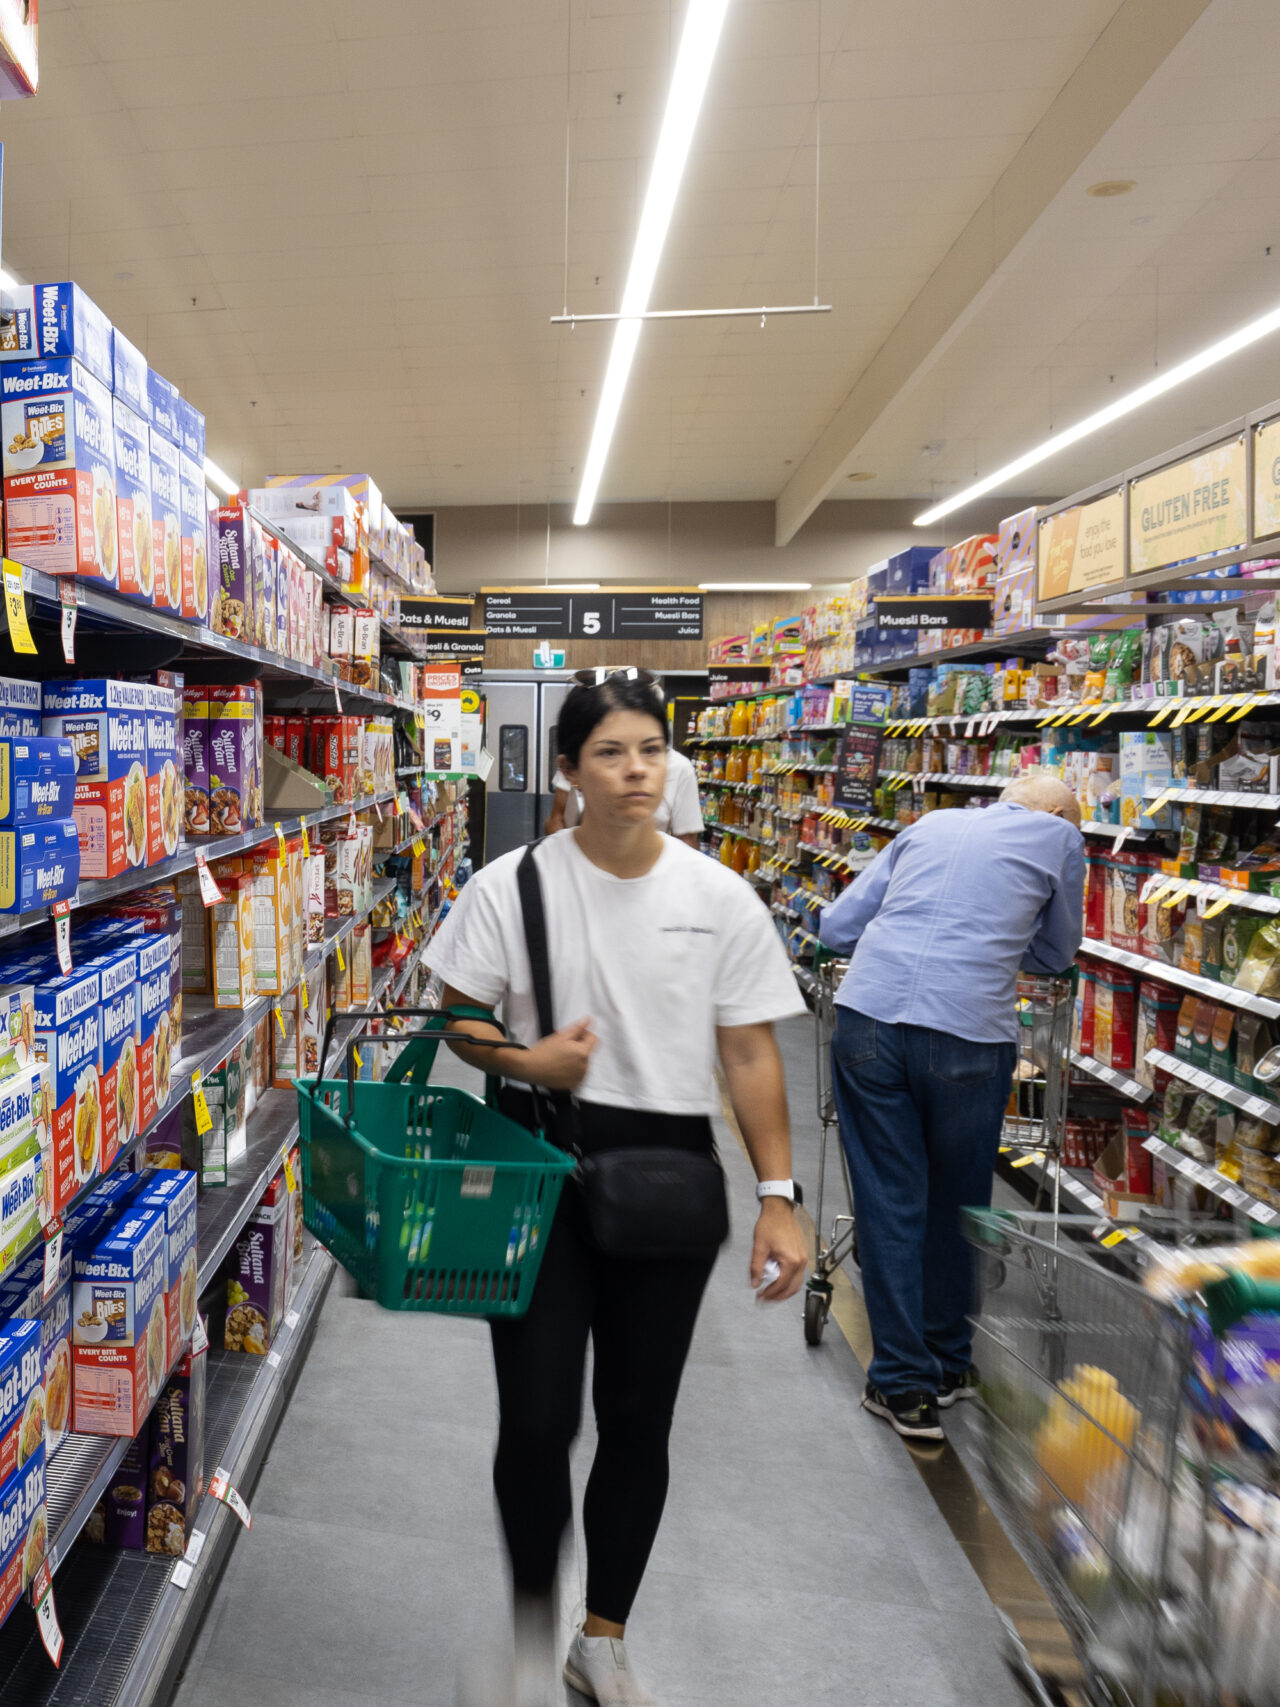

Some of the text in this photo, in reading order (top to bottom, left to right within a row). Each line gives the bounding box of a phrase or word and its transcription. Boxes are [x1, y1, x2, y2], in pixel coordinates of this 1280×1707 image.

[42, 285, 59, 354] Weet-Bix
[3, 372, 70, 394] Weet-Bix
[10, 472, 55, 488] EVERY BITE
[33, 479, 68, 490] COUNTS
[1141, 493, 1191, 533] GLUTEN
[1193, 478, 1230, 516] FREE
[651, 597, 699, 605] Health Food
[399, 613, 468, 626] Oats & Muesli
[486, 611, 516, 619] Granola
[655, 612, 699, 620] Muesli Bars
[879, 614, 948, 625] Muesli Bars
[582, 612, 601, 635] 5
[423, 642, 442, 651] uesli
[451, 643, 484, 651] Granola
[464, 666, 482, 674] Oats
[123, 684, 135, 704] VALUE
[44, 694, 104, 710] Weet-Bix
[426, 709, 441, 722] $9
[212, 736, 225, 766] Bran
[221, 728, 237, 773] Sultana
[37, 804, 53, 816] Hi-Bran
[58, 1016, 99, 1072] Weet-Bix
